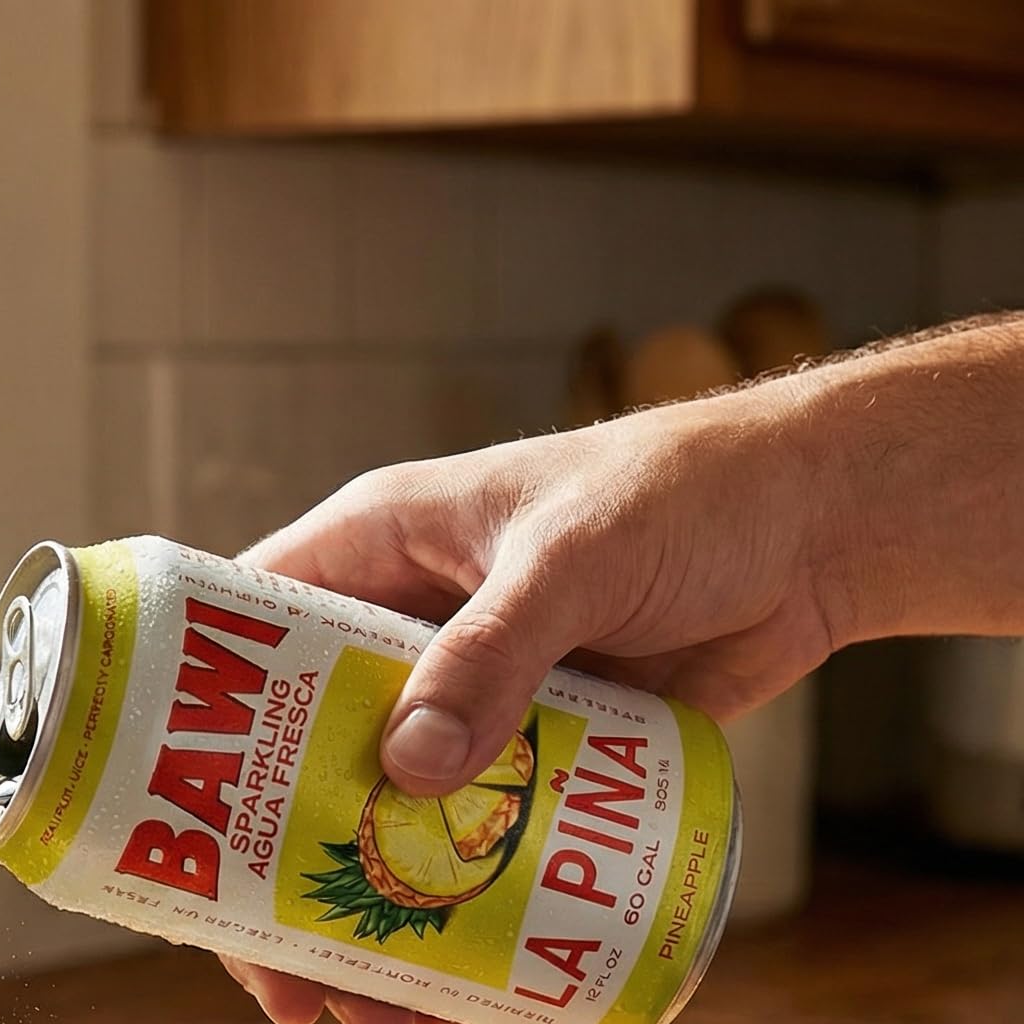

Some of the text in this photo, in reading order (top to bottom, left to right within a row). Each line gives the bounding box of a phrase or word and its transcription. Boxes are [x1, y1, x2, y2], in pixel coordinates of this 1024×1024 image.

[114, 596, 290, 902] BAWI
[230, 679, 291, 854] SPARKLING
[248, 671, 319, 880] AGUA FRESCA
[540, 735, 649, 909] PIÑA
[623, 892, 645, 926] 60
[658, 829, 709, 961] PINEAPPLE
[514, 937, 602, 1008] LA
[584, 985, 601, 1002] 12
[605, 947, 623, 970] OZ
